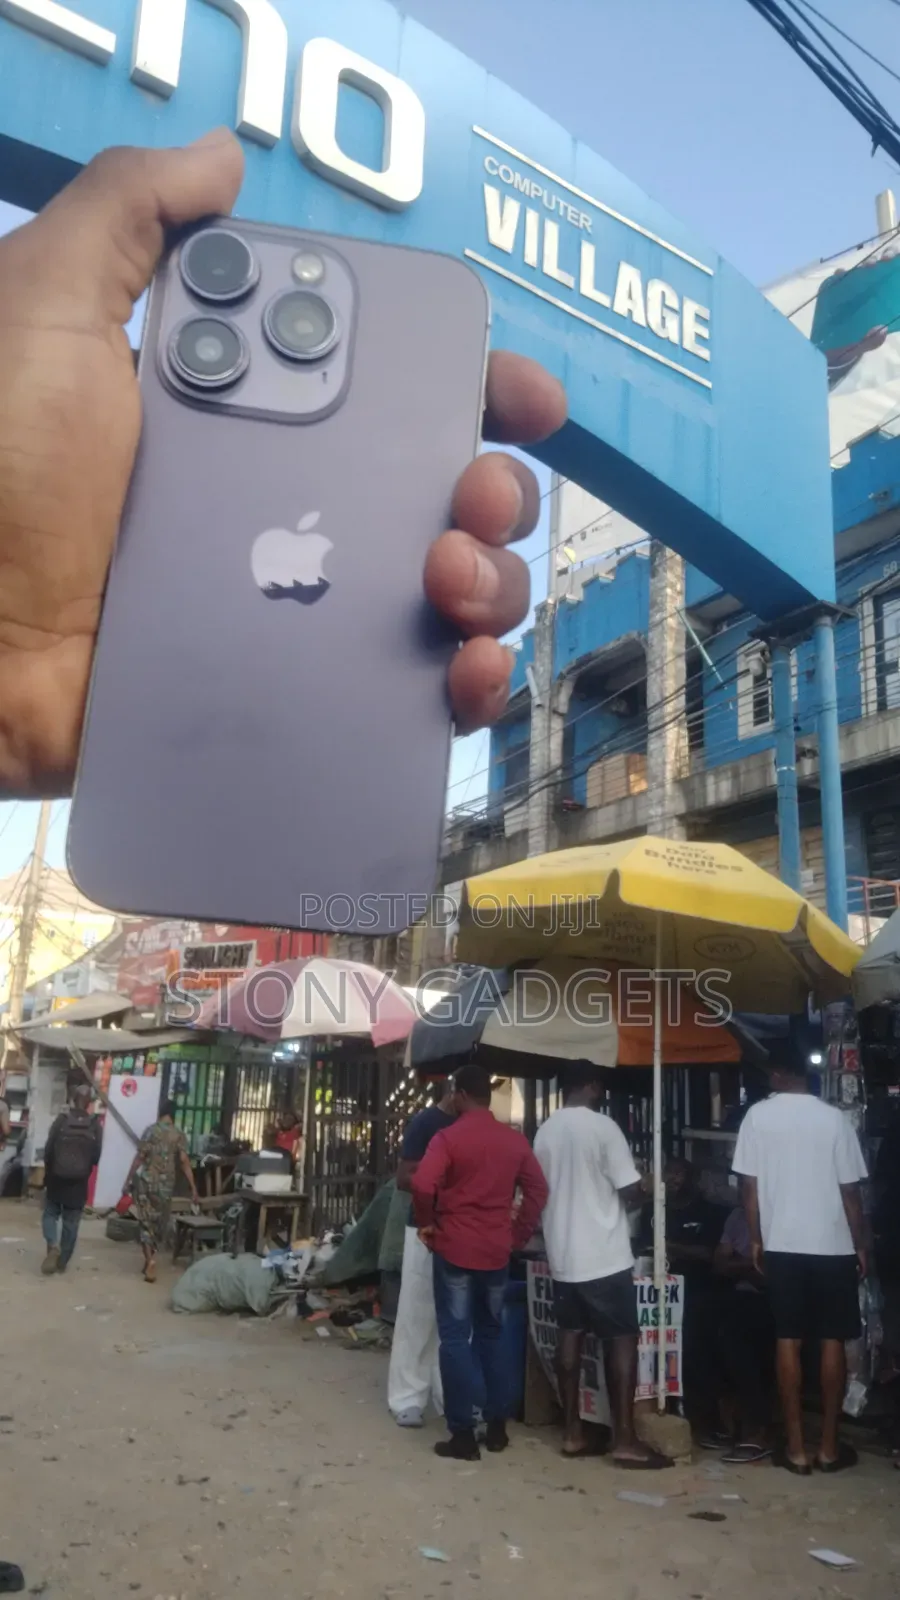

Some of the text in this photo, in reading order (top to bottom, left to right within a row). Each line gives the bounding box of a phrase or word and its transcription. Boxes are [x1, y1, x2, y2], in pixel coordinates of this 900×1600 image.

[483, 156, 593, 234] COMPUTER
[483, 183, 711, 362] VILLAGE
[644, 848, 744, 872] Bundles
[646, 1329, 678, 1345] PHNE
